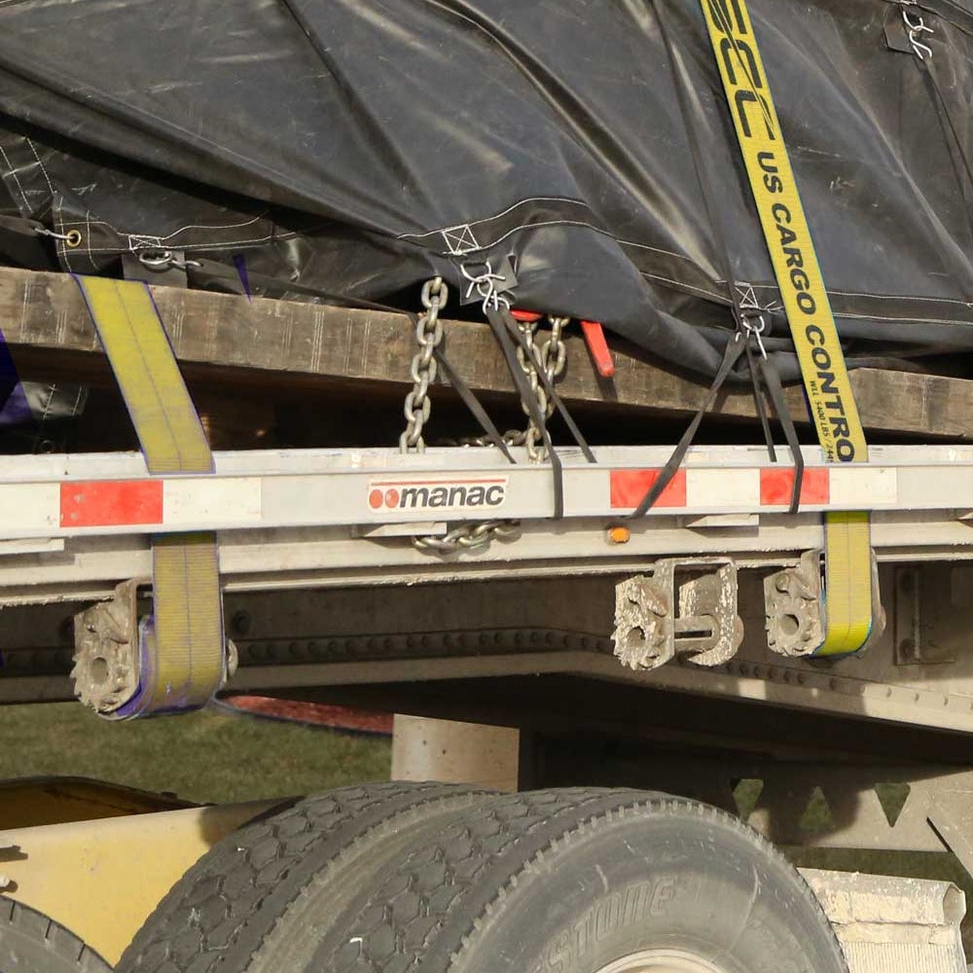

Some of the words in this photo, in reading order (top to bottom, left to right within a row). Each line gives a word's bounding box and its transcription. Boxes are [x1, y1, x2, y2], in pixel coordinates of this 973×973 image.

[757, 151, 784, 194] US
[771, 202, 817, 316] CARGO
[805, 325, 855, 462] CONTRO
[400, 485, 504, 508] manac
